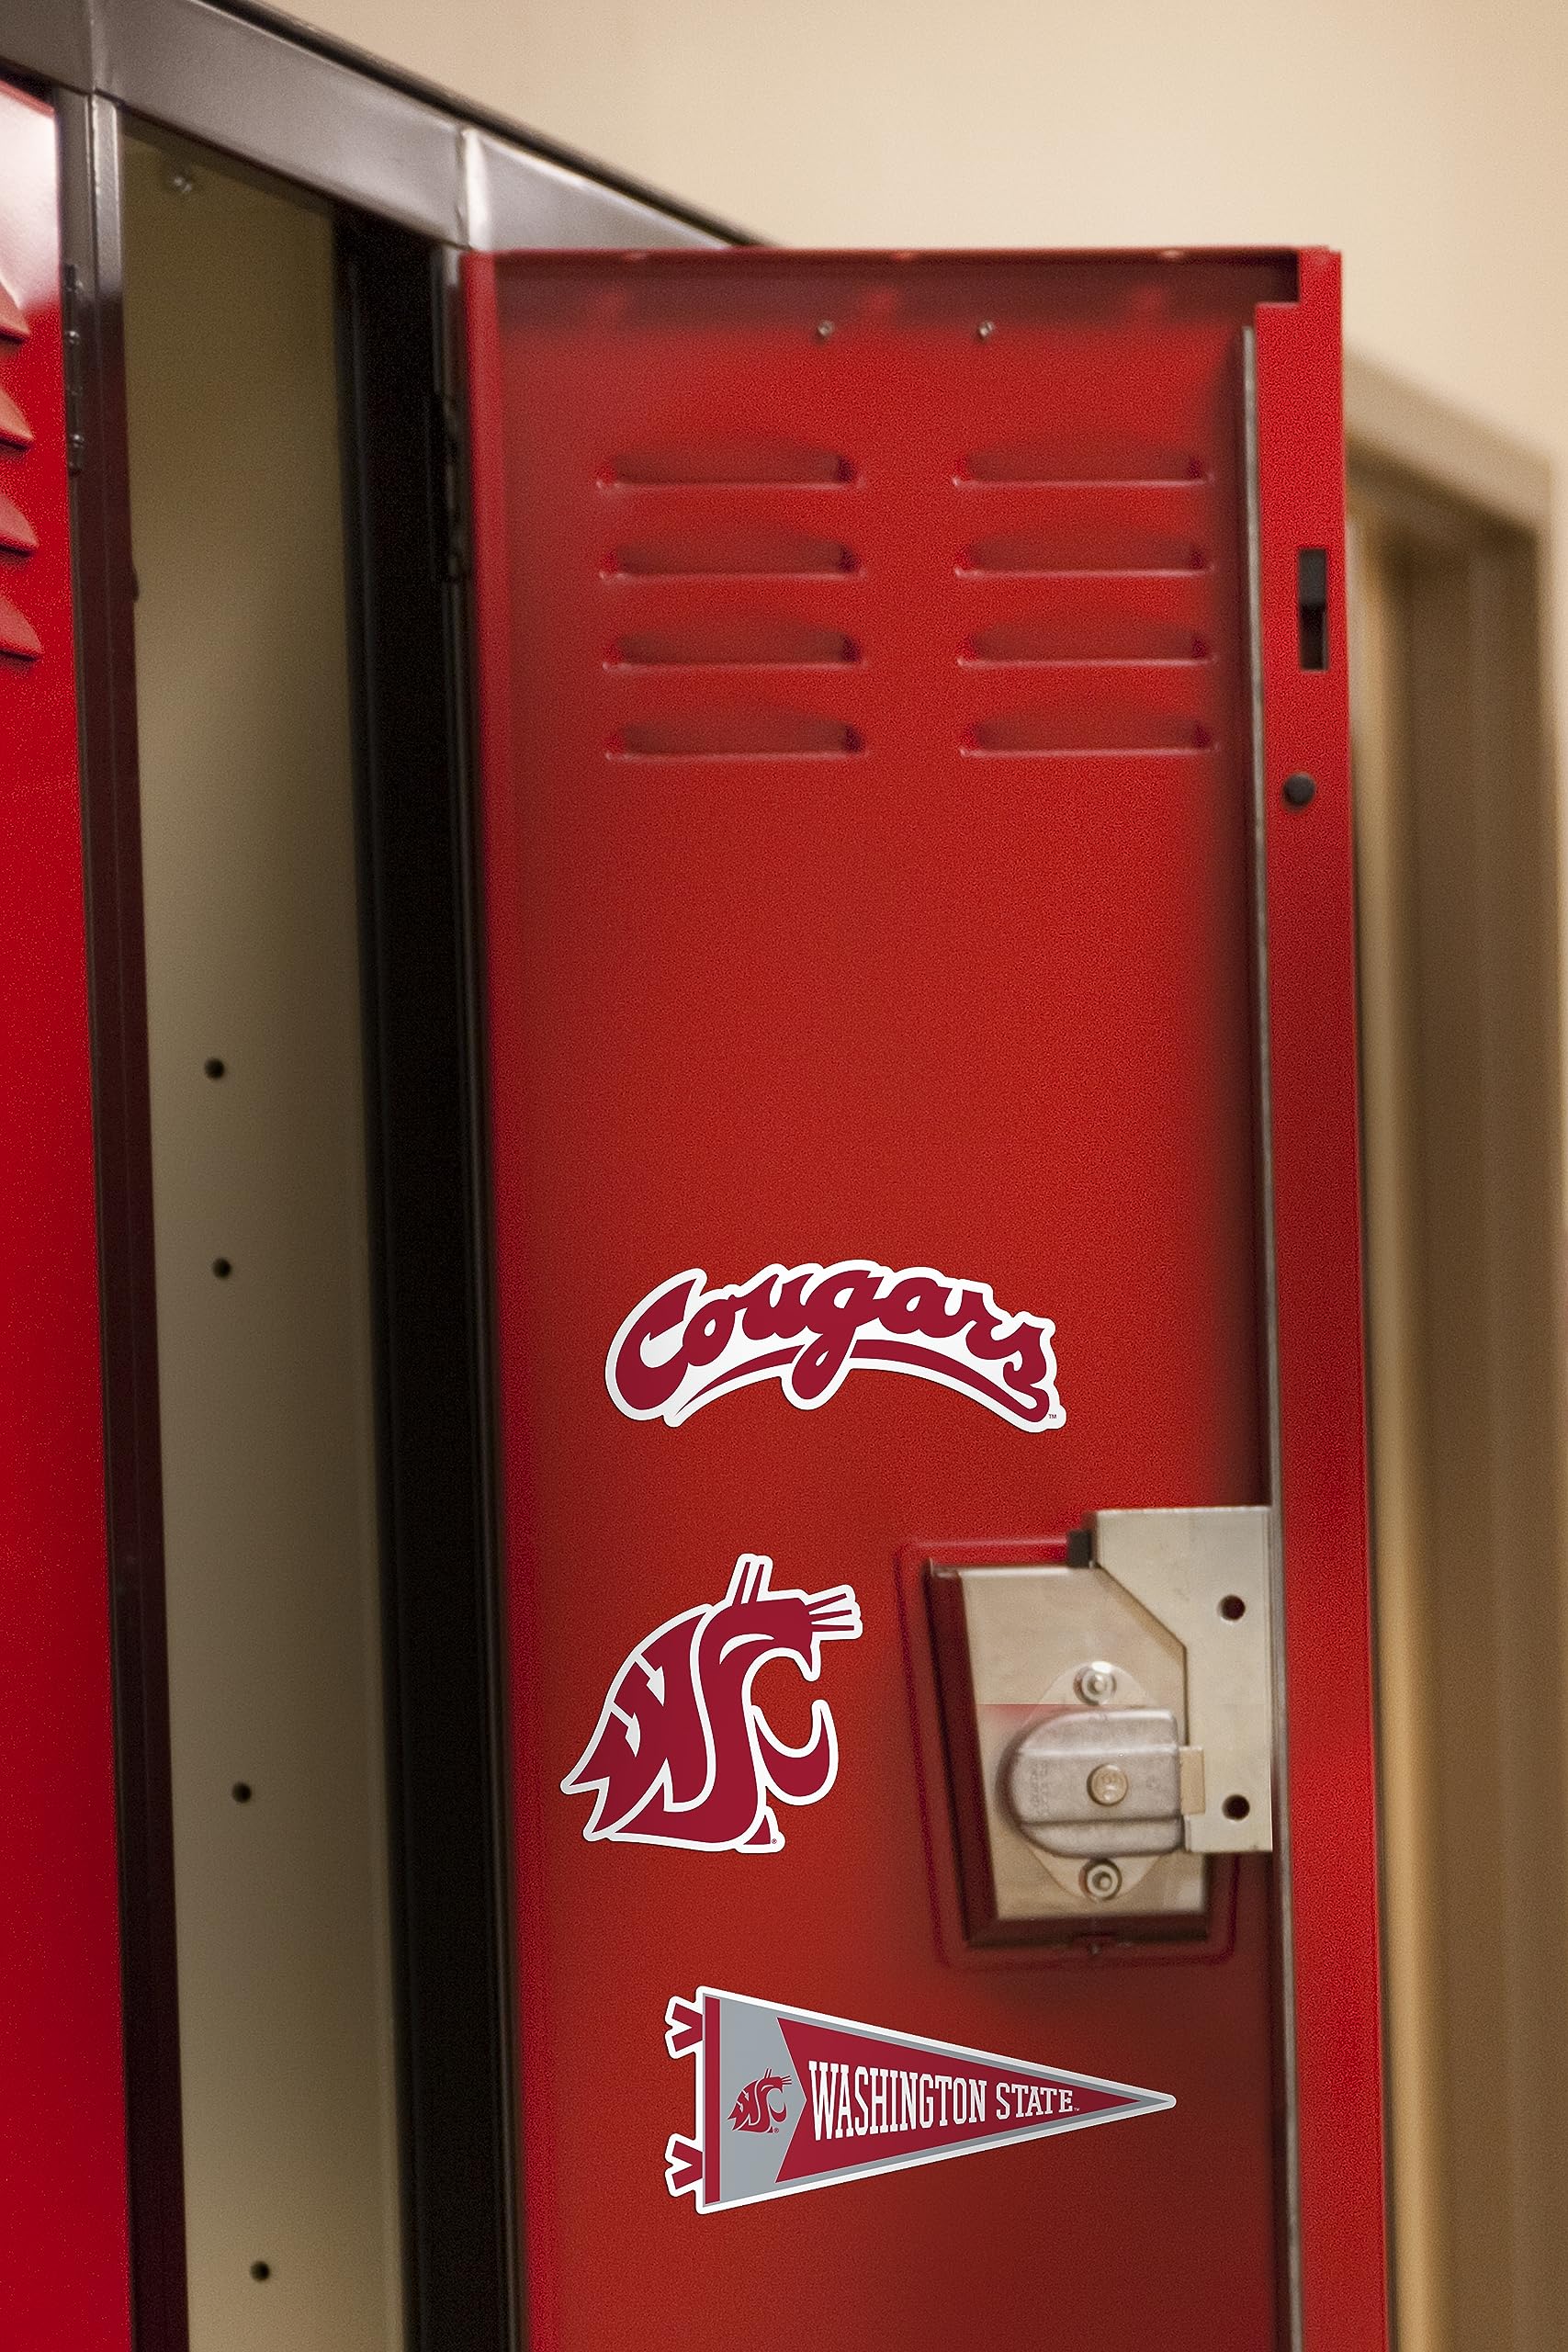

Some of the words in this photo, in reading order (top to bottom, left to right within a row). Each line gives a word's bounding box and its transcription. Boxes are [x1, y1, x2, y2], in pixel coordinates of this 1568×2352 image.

[615, 1269, 1050, 1423] Cougars
[808, 2060, 987, 2141] WASHINGTON
[996, 2082, 1073, 2120] STATE
